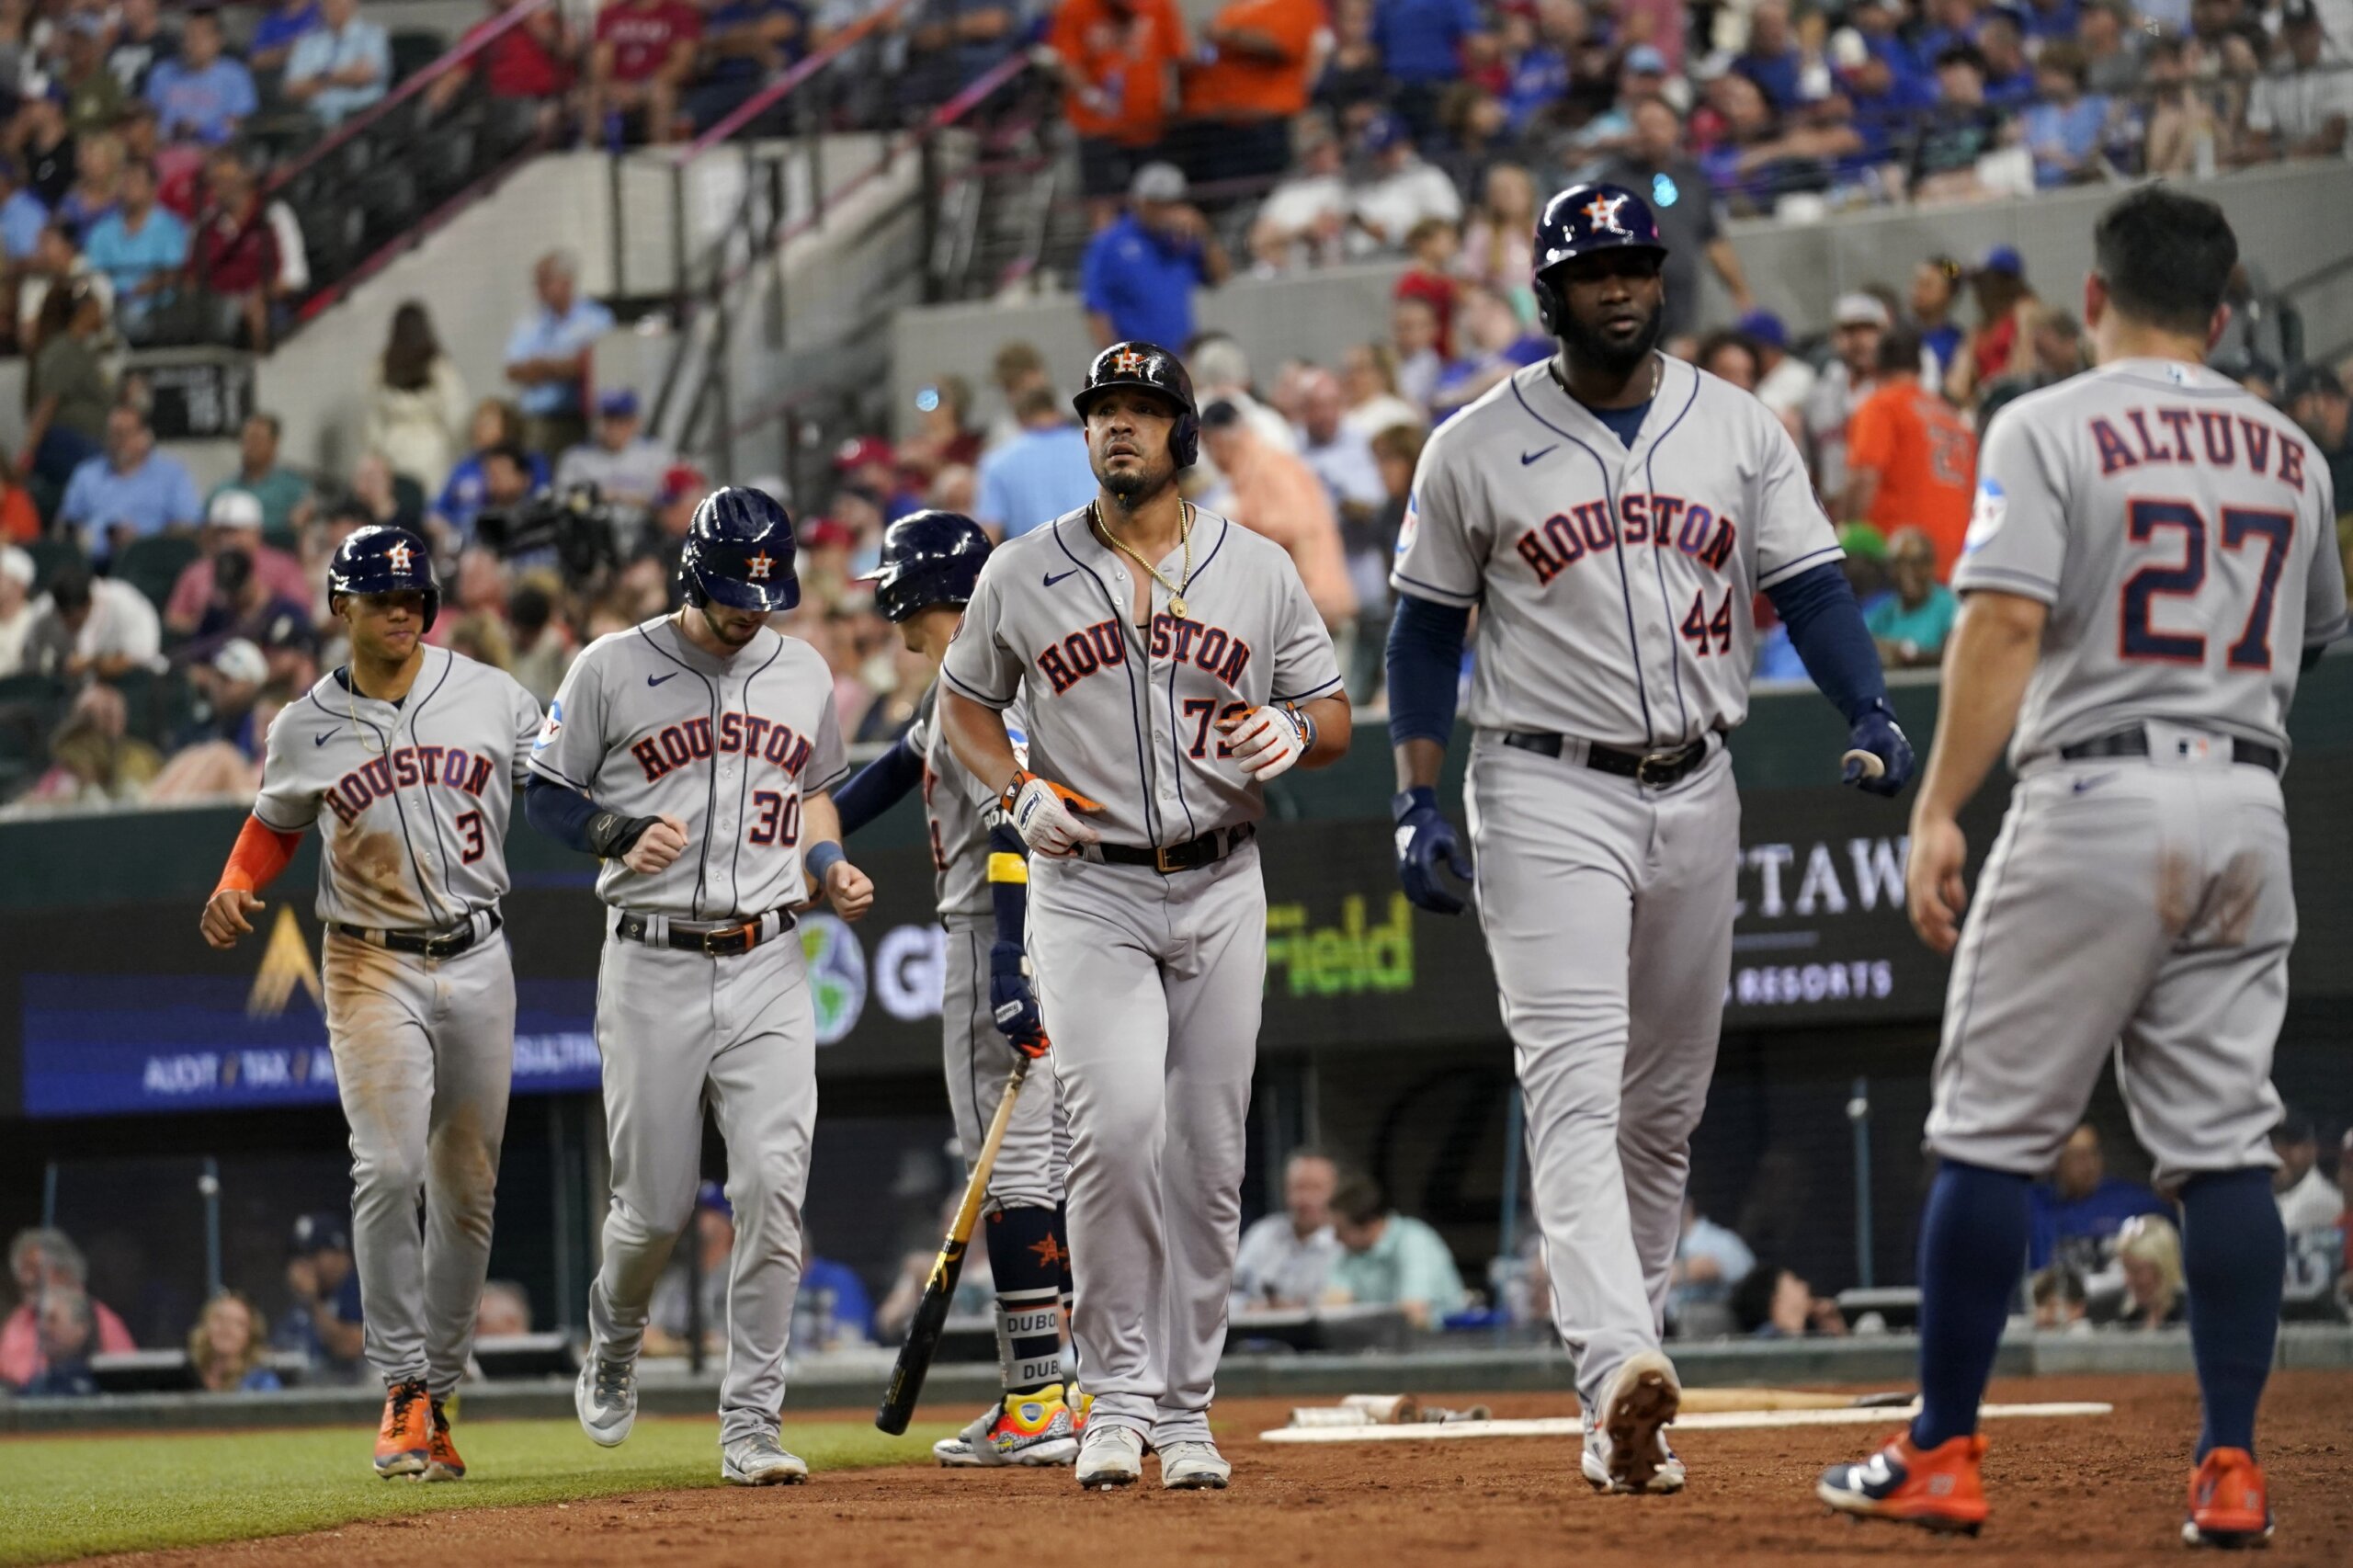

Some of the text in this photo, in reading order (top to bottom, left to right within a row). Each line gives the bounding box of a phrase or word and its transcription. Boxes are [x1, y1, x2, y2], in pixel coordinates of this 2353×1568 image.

[2089, 408, 2305, 494] ALTUVE
[1516, 494, 1736, 588] HOUSTON
[1679, 583, 1733, 657] 44
[2118, 495, 2296, 672] 27
[1037, 612, 1250, 697] HOUSTON
[631, 710, 813, 783] HOUSTON
[324, 745, 494, 827] HOUSTON
[749, 790, 800, 847] 30
[456, 809, 485, 865] 3
[1736, 835, 1911, 916] TAW
[1007, 1312, 1059, 1333] DUBO
[1024, 1359, 1062, 1380] DUB
